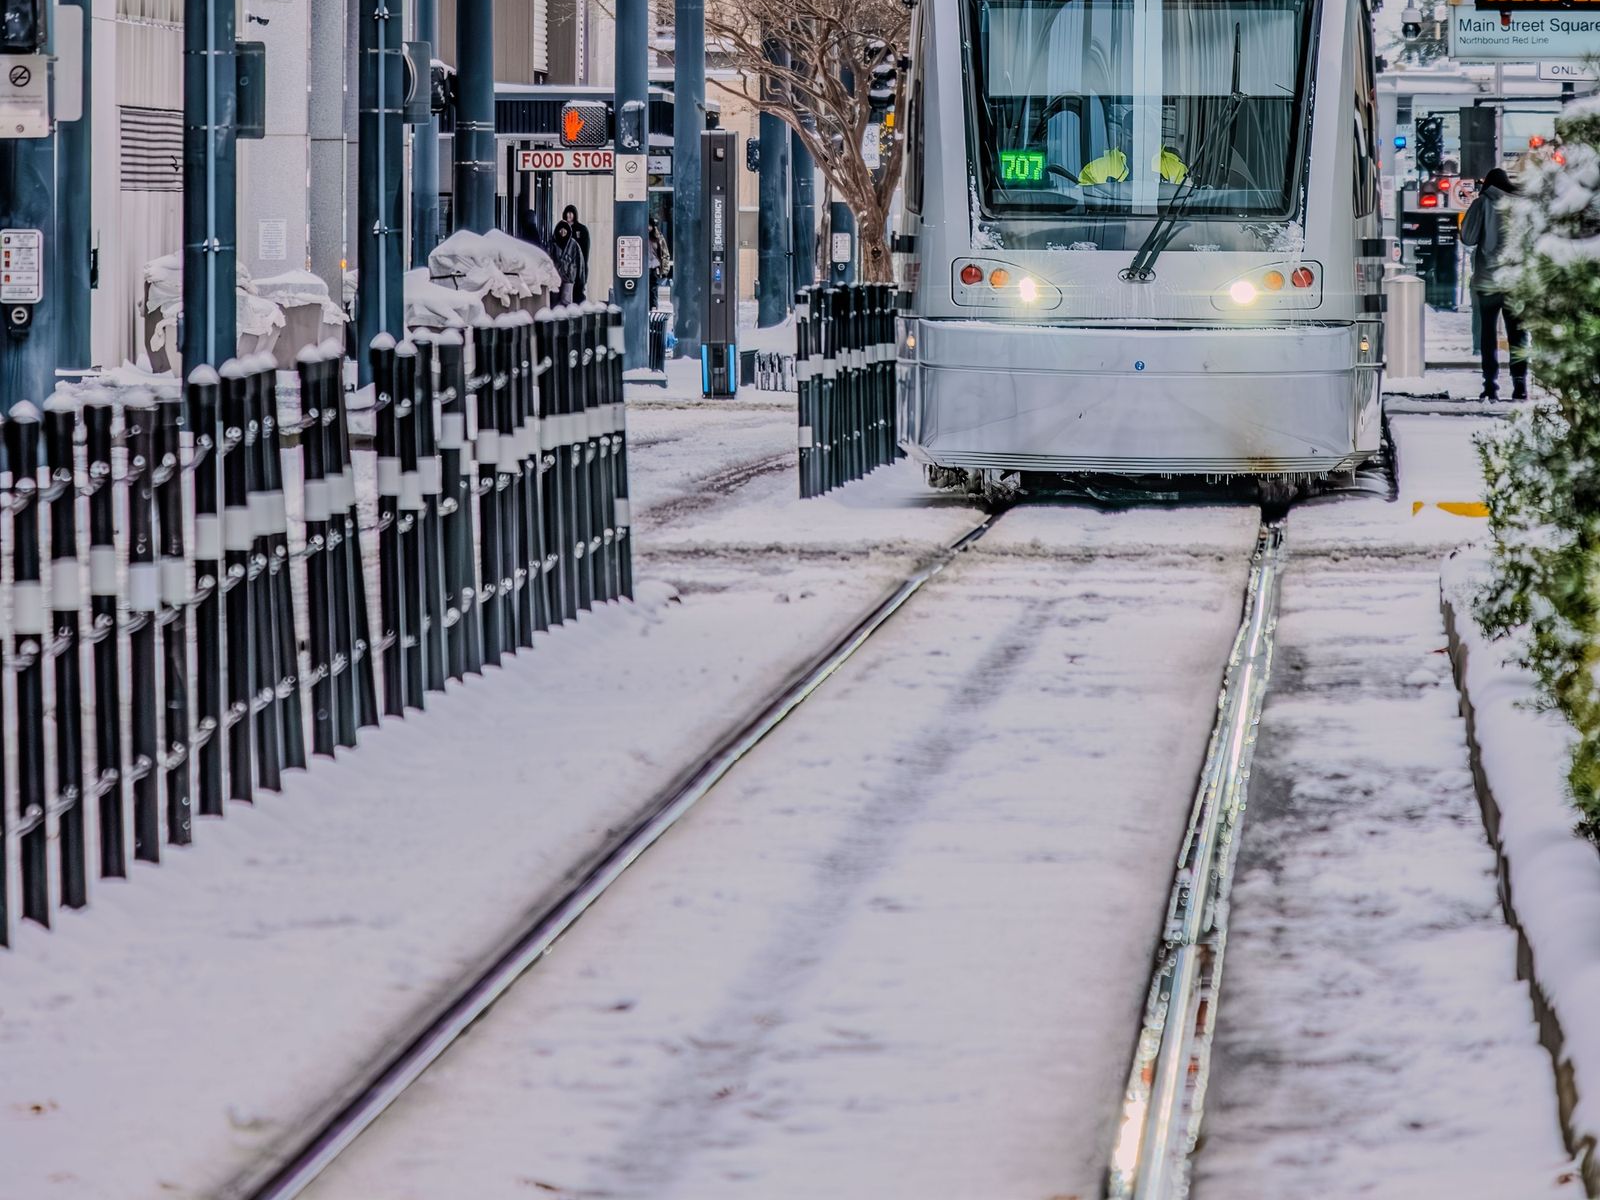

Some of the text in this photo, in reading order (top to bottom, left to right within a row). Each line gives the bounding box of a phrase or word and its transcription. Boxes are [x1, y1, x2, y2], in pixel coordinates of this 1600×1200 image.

[1459, 18, 1495, 32] Main
[1460, 36, 1549, 44] Northbound Red Line
[522, 153, 565, 168] FOOD
[1002, 155, 1043, 180] 707
[714, 198, 722, 245] EMERGENCY
